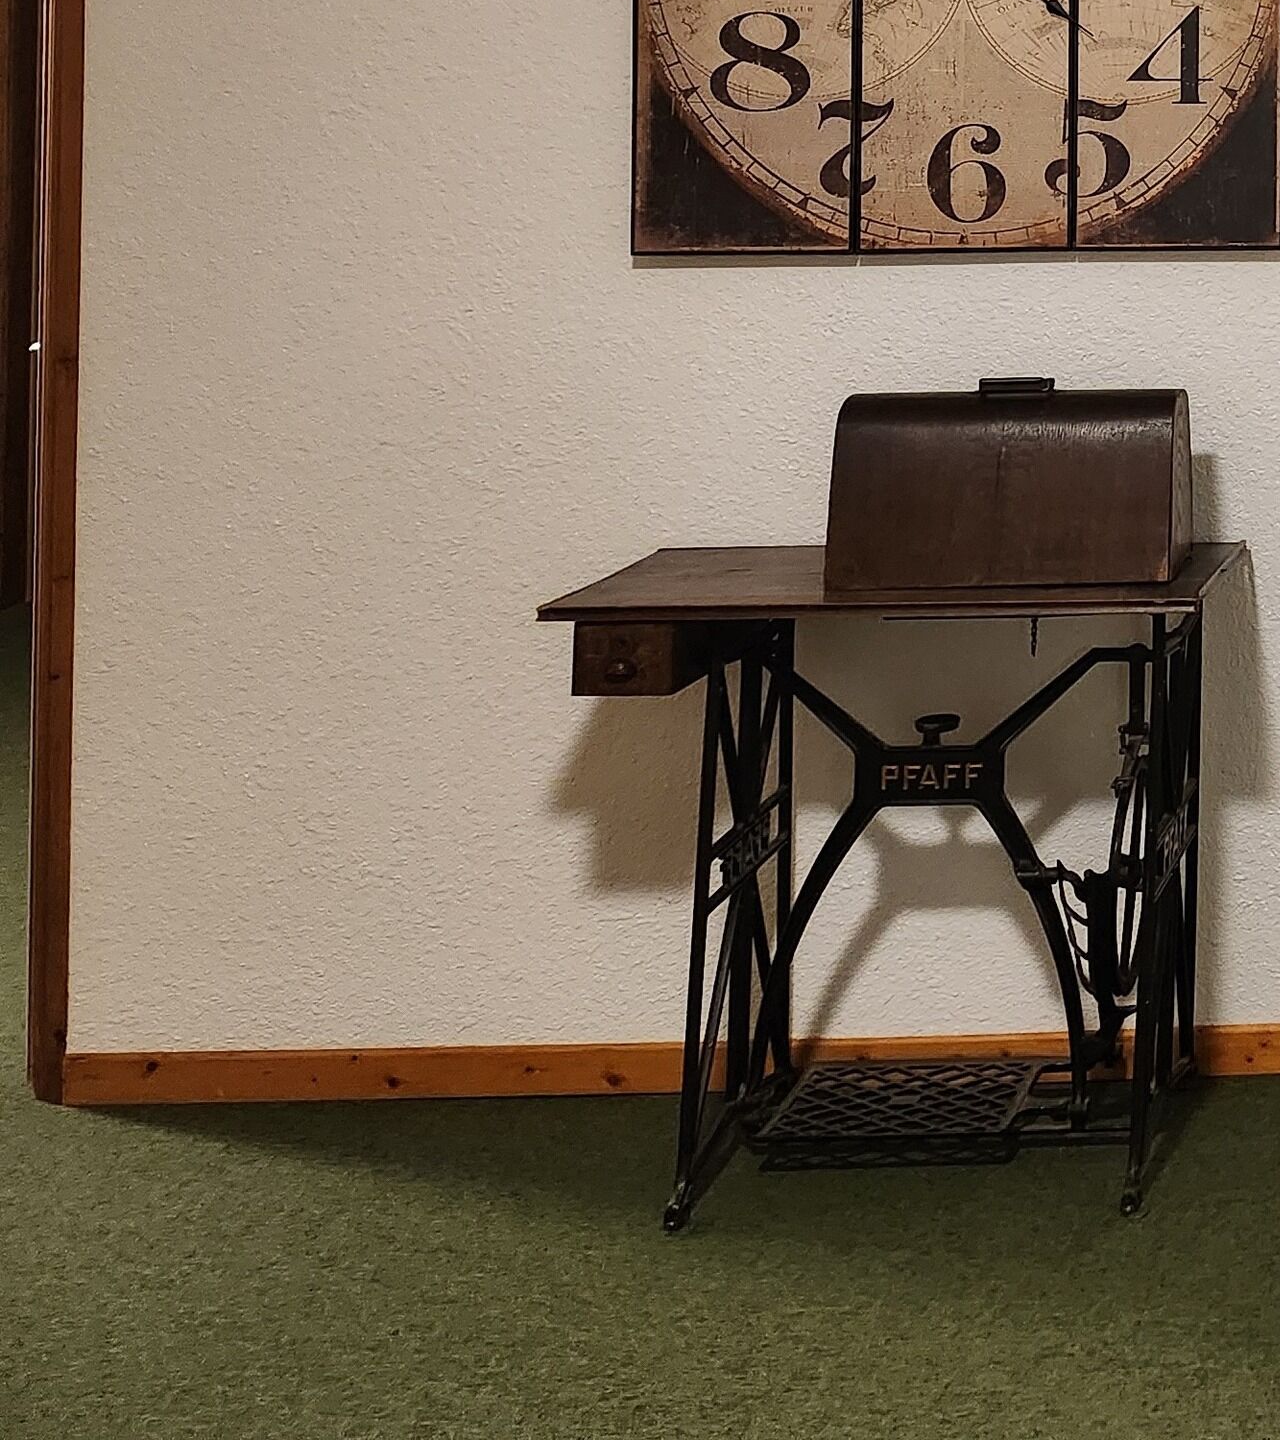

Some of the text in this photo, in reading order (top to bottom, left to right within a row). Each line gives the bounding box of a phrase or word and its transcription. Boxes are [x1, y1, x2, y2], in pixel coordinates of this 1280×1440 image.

[710, 11, 812, 112] 8
[1127, 6, 1214, 105] 4
[818, 97, 895, 198] 7
[927, 123, 1008, 224] 6
[1044, 98, 1131, 199] 5
[881, 763, 984, 791] PFAFF
